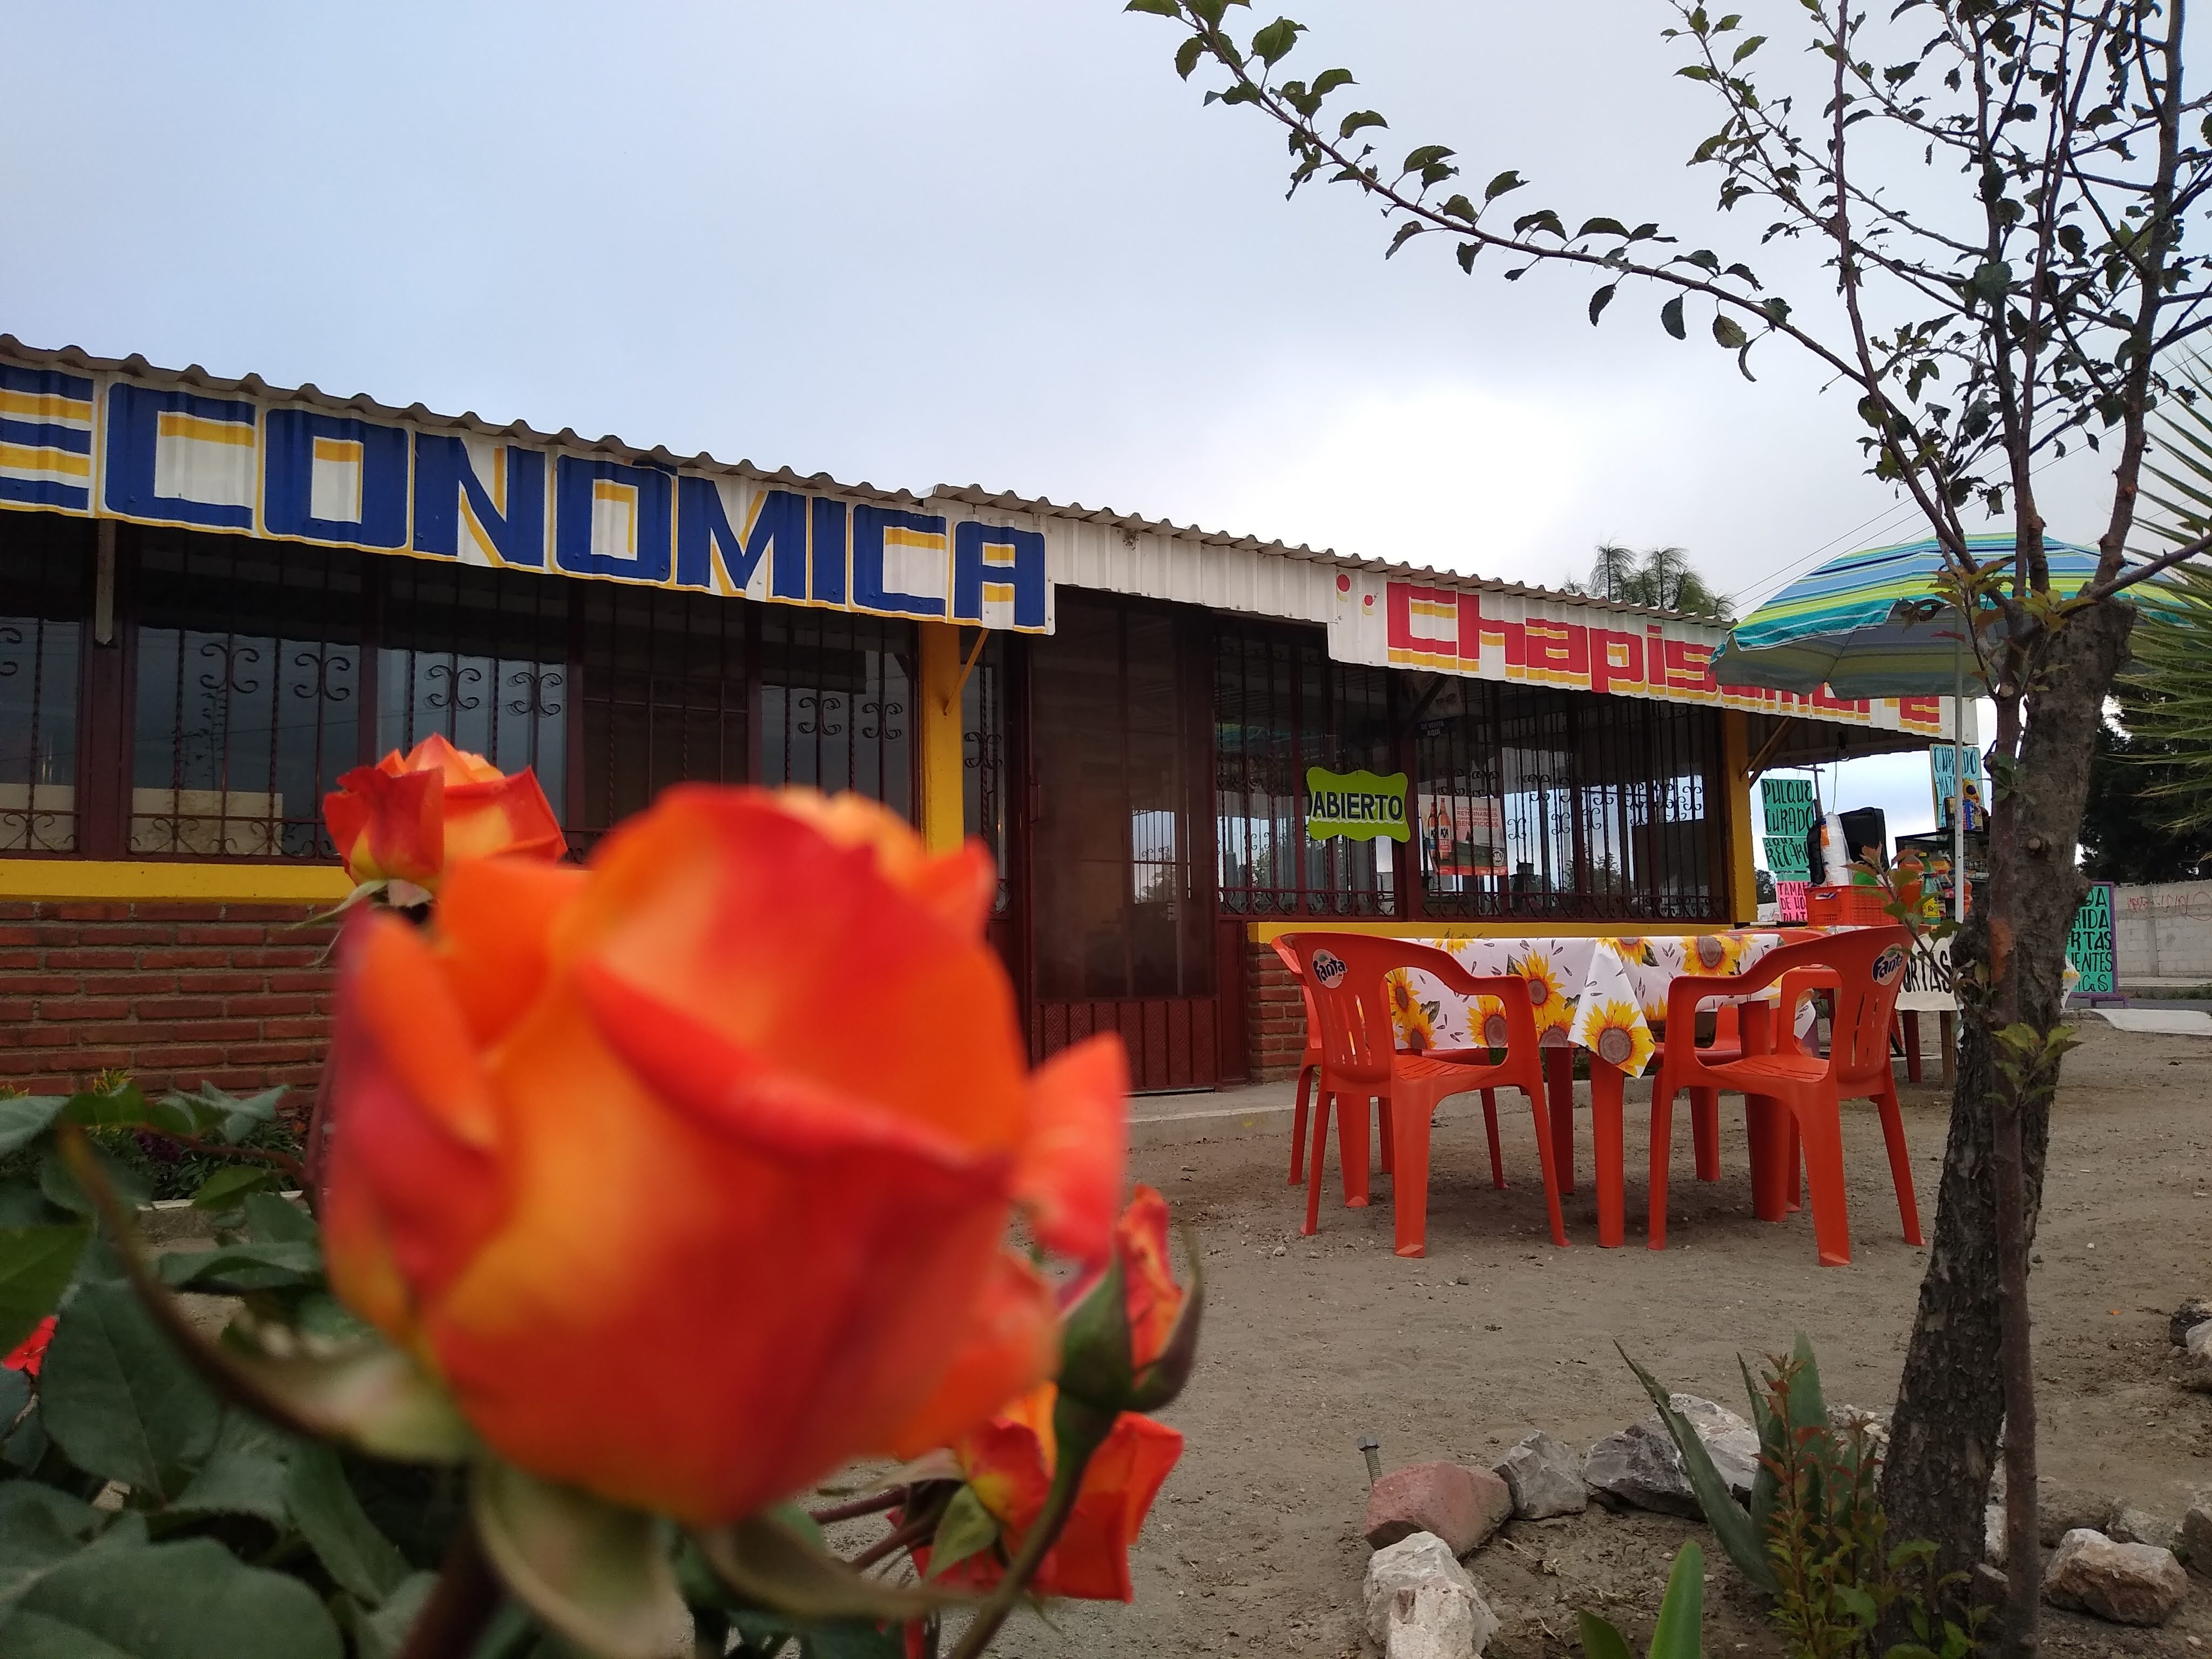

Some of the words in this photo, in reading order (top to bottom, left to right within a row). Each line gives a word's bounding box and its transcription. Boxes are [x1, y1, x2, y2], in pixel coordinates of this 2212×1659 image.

[1934, 747, 1977, 775] CURDO
[1761, 780, 1812, 804] PULQUE
[1312, 791, 1403, 820] ABIERTO
[1765, 806, 1815, 835] CURADO
[1780, 897, 1792, 911] DE
[2071, 930, 2112, 952] RTAS
[1312, 957, 1346, 983] Fanta
[1898, 950, 1953, 994] ORTAS
[2071, 952, 2113, 973] IENTES
